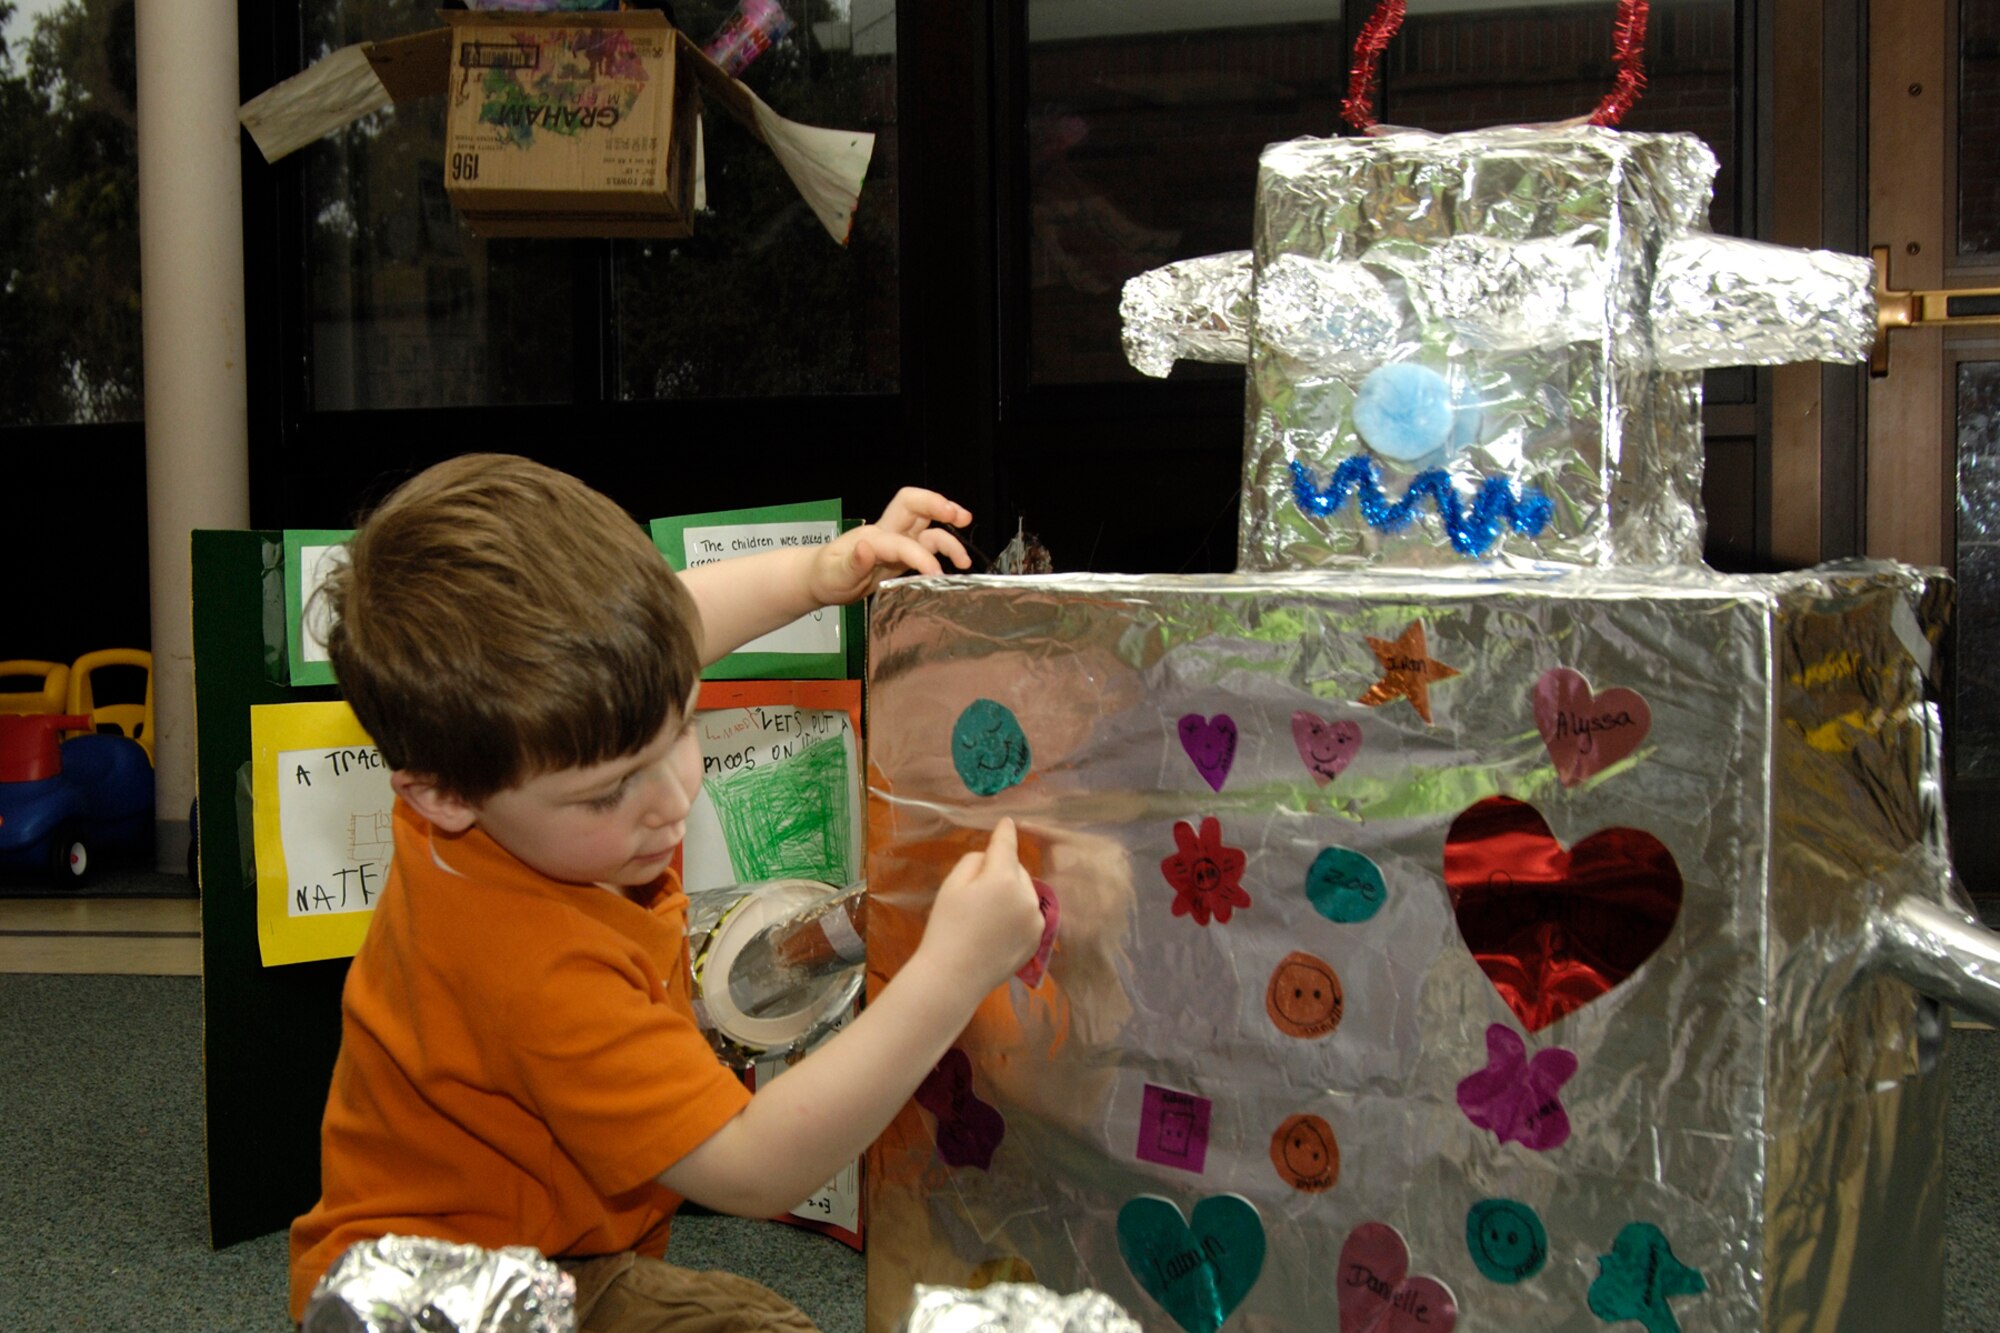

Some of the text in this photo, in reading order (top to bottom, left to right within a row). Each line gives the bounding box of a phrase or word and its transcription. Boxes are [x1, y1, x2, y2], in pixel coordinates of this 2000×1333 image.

[498, 104, 620, 129] GRAHAM
[452, 152, 480, 182] 196
[700, 539, 724, 553] The
[780, 535, 799, 546] were
[801, 533, 822, 545] asked
[811, 713, 834, 734] PUT
[841, 718, 849, 734] A
[1556, 711, 1637, 754] Alyssa
[772, 740, 793, 760] ON
[296, 763, 312, 786] A
